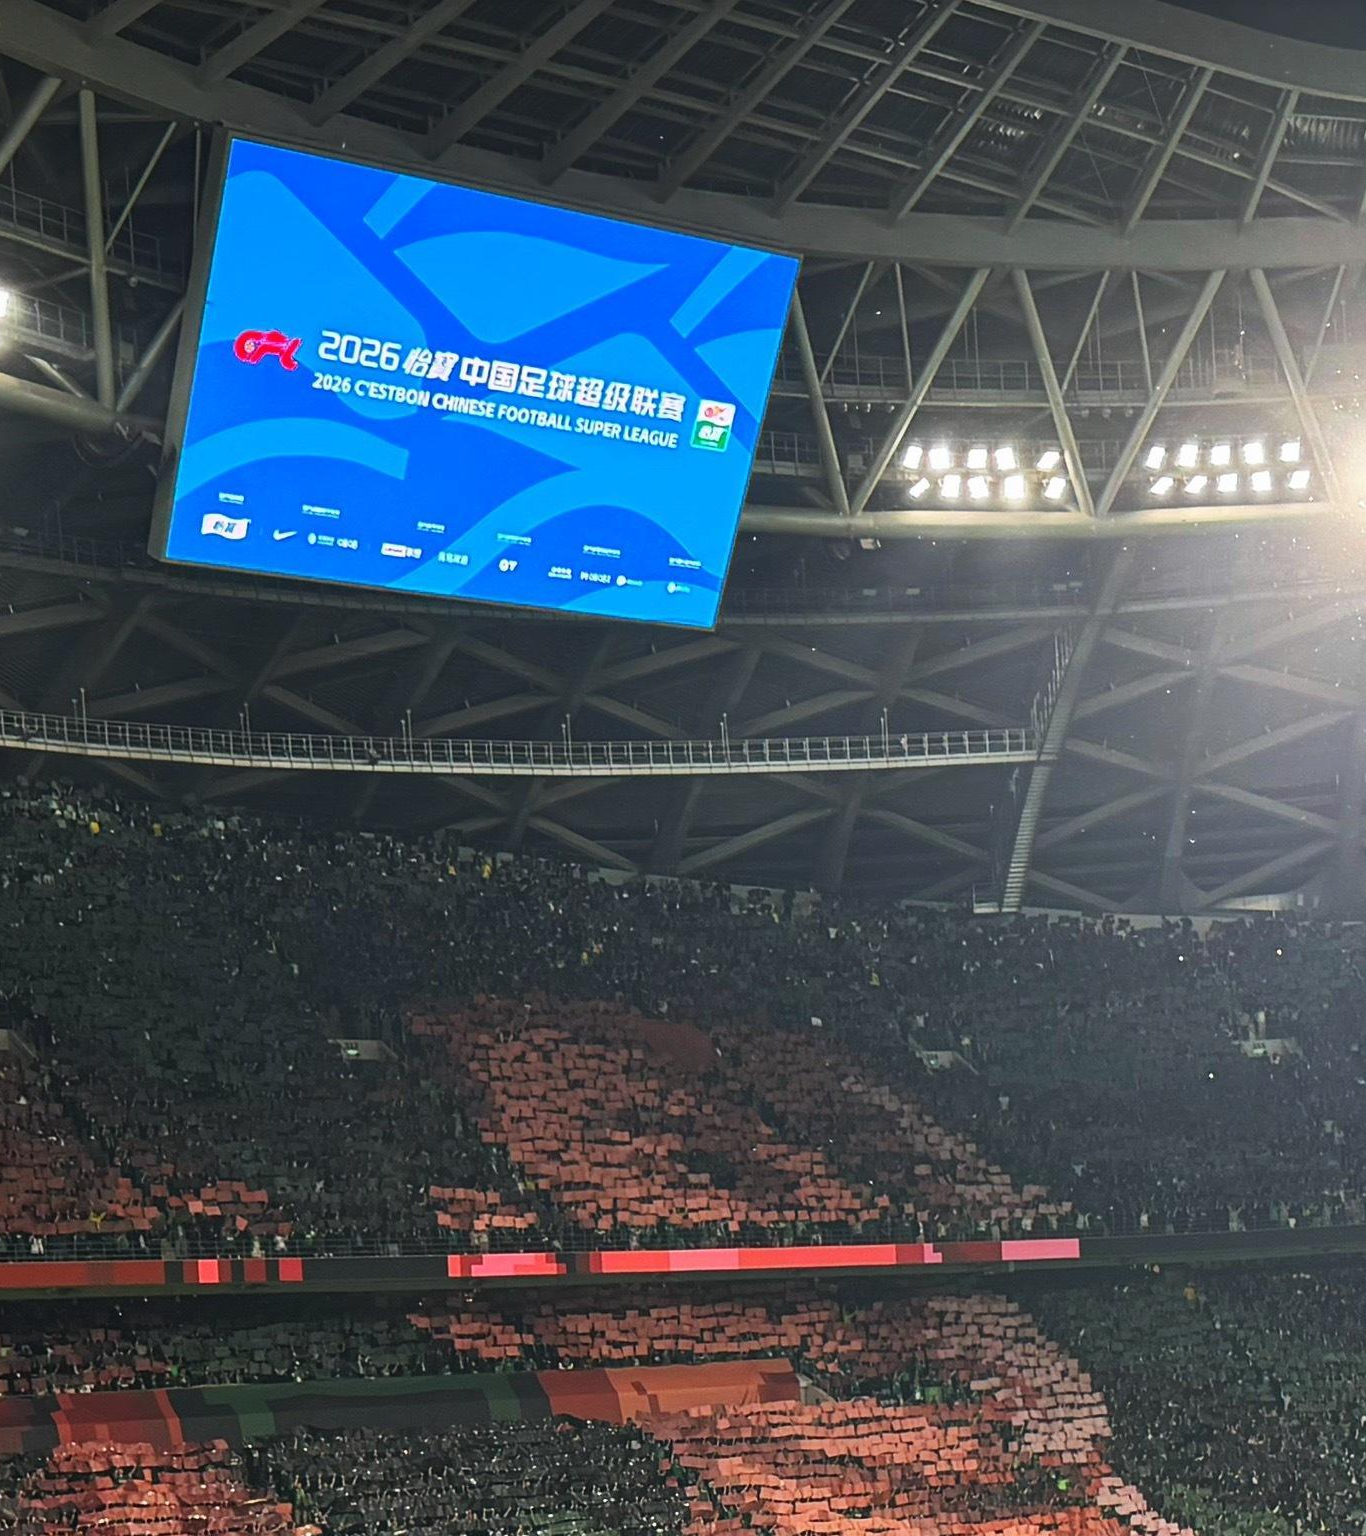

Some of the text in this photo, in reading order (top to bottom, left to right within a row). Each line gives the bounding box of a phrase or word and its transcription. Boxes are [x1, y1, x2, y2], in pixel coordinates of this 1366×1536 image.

[312, 372, 679, 449] 2026 C'ESTBON CHINESE FOOTBALL SUPER LEAGUE
[318, 330, 402, 371] 2026
[459, 356, 686, 422] 中国足球超级联赛
